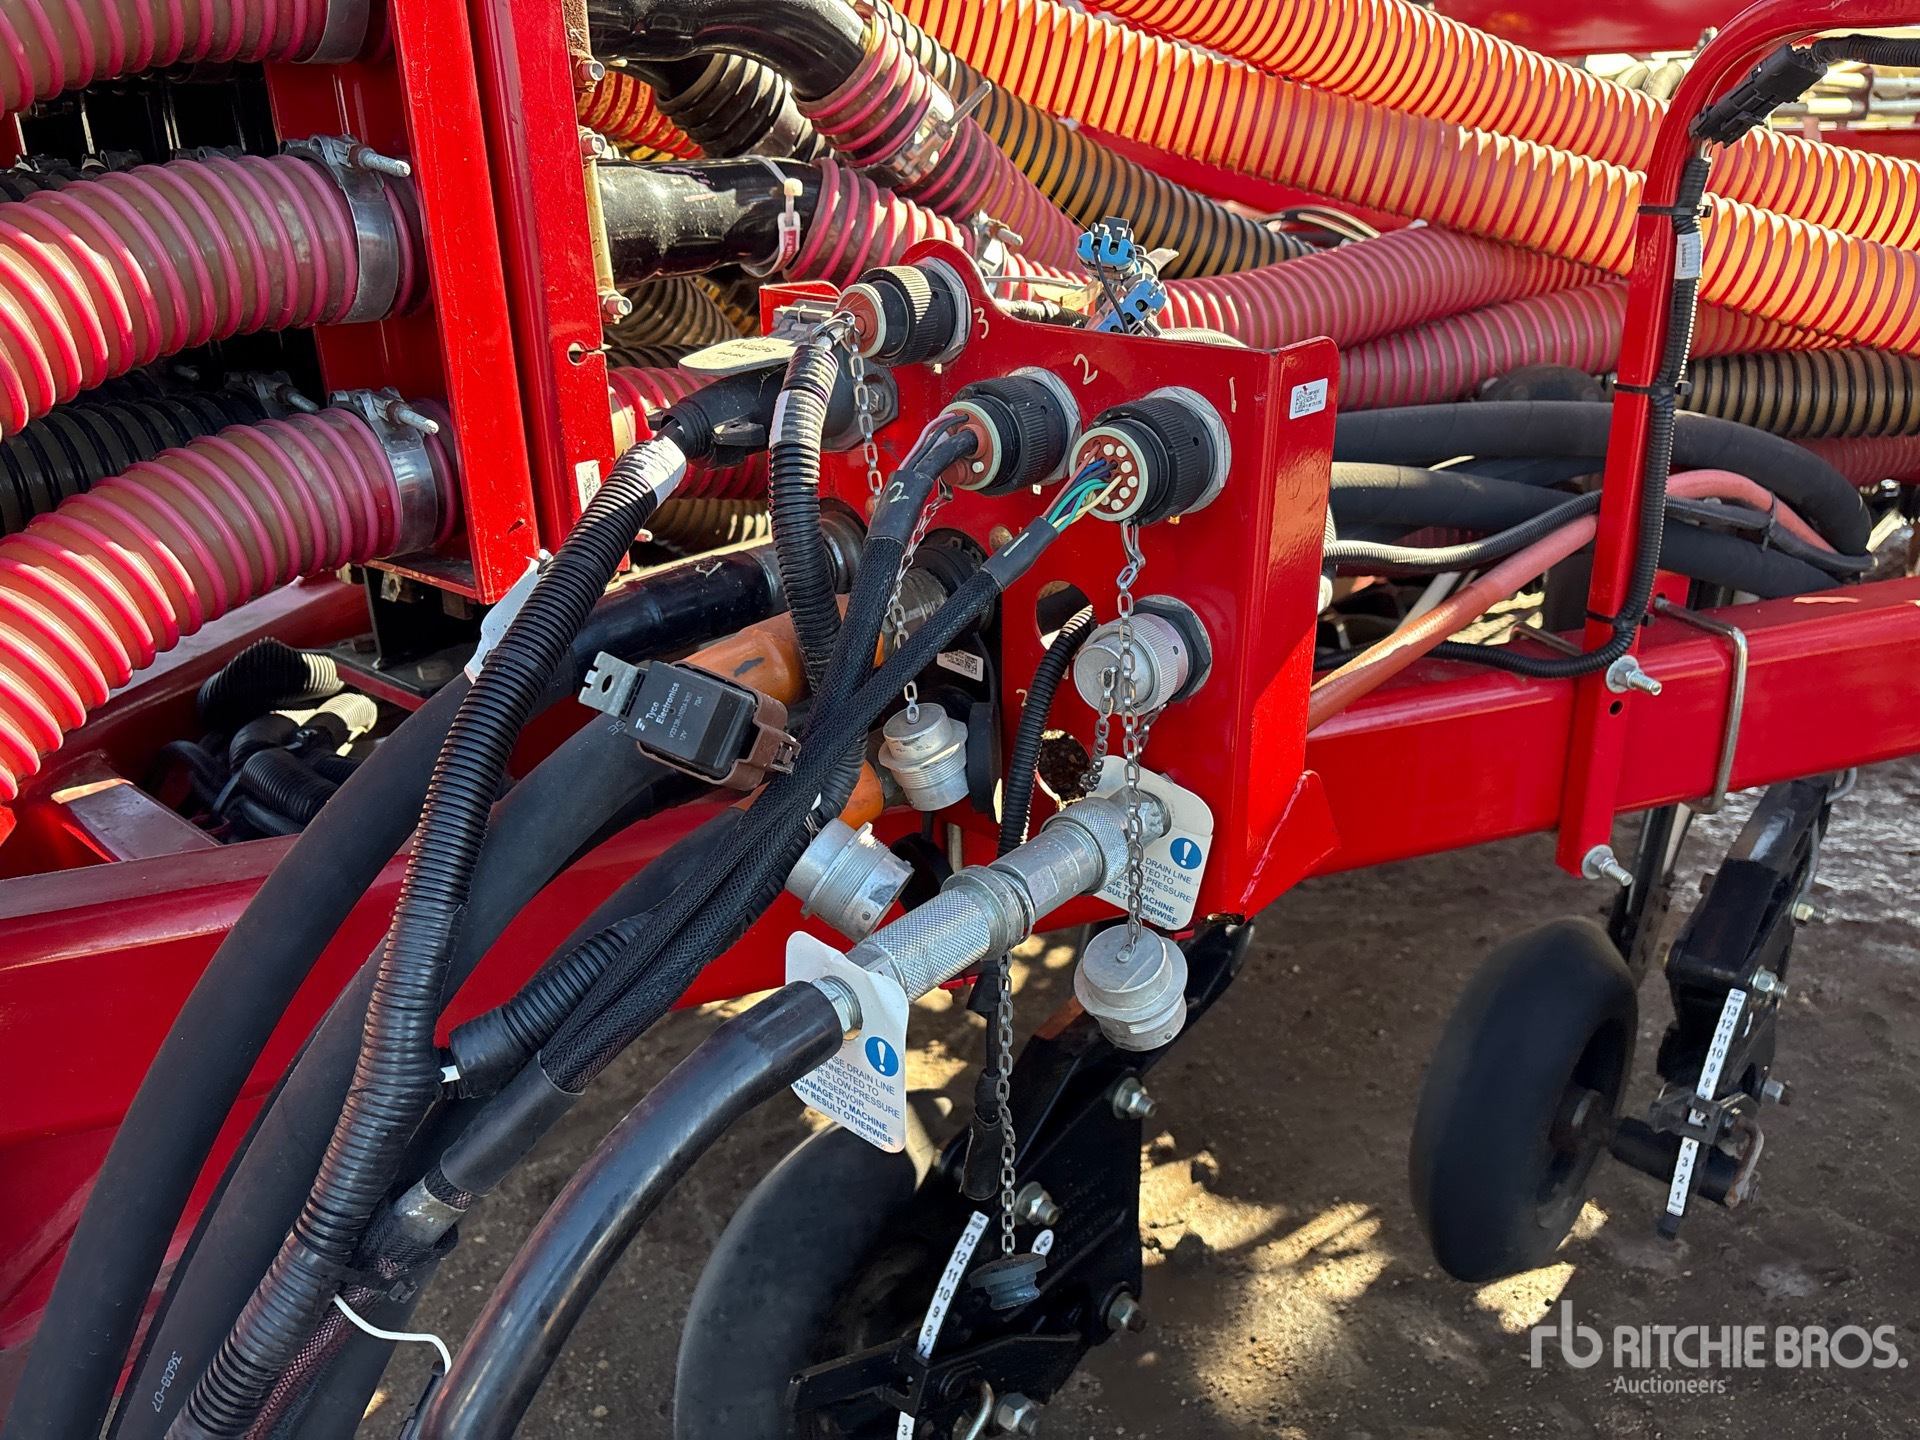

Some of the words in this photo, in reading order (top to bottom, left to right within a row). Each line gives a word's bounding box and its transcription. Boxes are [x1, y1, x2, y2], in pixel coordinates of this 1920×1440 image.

[974, 307, 989, 339] 3
[1073, 353, 1098, 385] 2
[889, 481, 909, 503] 2
[645, 701, 660, 719] Tyco
[656, 682, 680, 725] Electronics
[1145, 857, 1171, 875] DRAIN
[1172, 870, 1192, 885] LINE
[1162, 874, 1174, 885] TO
[1102, 887, 1128, 900] SULT
[1726, 1005, 1738, 1017] 13
[1721, 1019, 1733, 1031] 12
[1717, 1033, 1728, 1045] 11
[1711, 1047, 1723, 1059] 10
[847, 1063, 873, 1084] DRAIN
[875, 1078, 895, 1096] LINE
[817, 1076, 867, 1110] RESERVOIR.
[832, 1075, 900, 1119] LOW-PRESSURE
[867, 1084, 879, 1096] TO
[793, 1082, 809, 1095] MAY
[811, 1092, 841, 1115] RESULT
[800, 1077, 834, 1101] DAMAGE
[835, 1097, 847, 1108] TO
[849, 1104, 888, 1132] MACHINE
[963, 1232, 976, 1247] 13
[955, 1250, 967, 1265] 12
[947, 1268, 959, 1283] 11
[938, 1286, 950, 1301] 10
